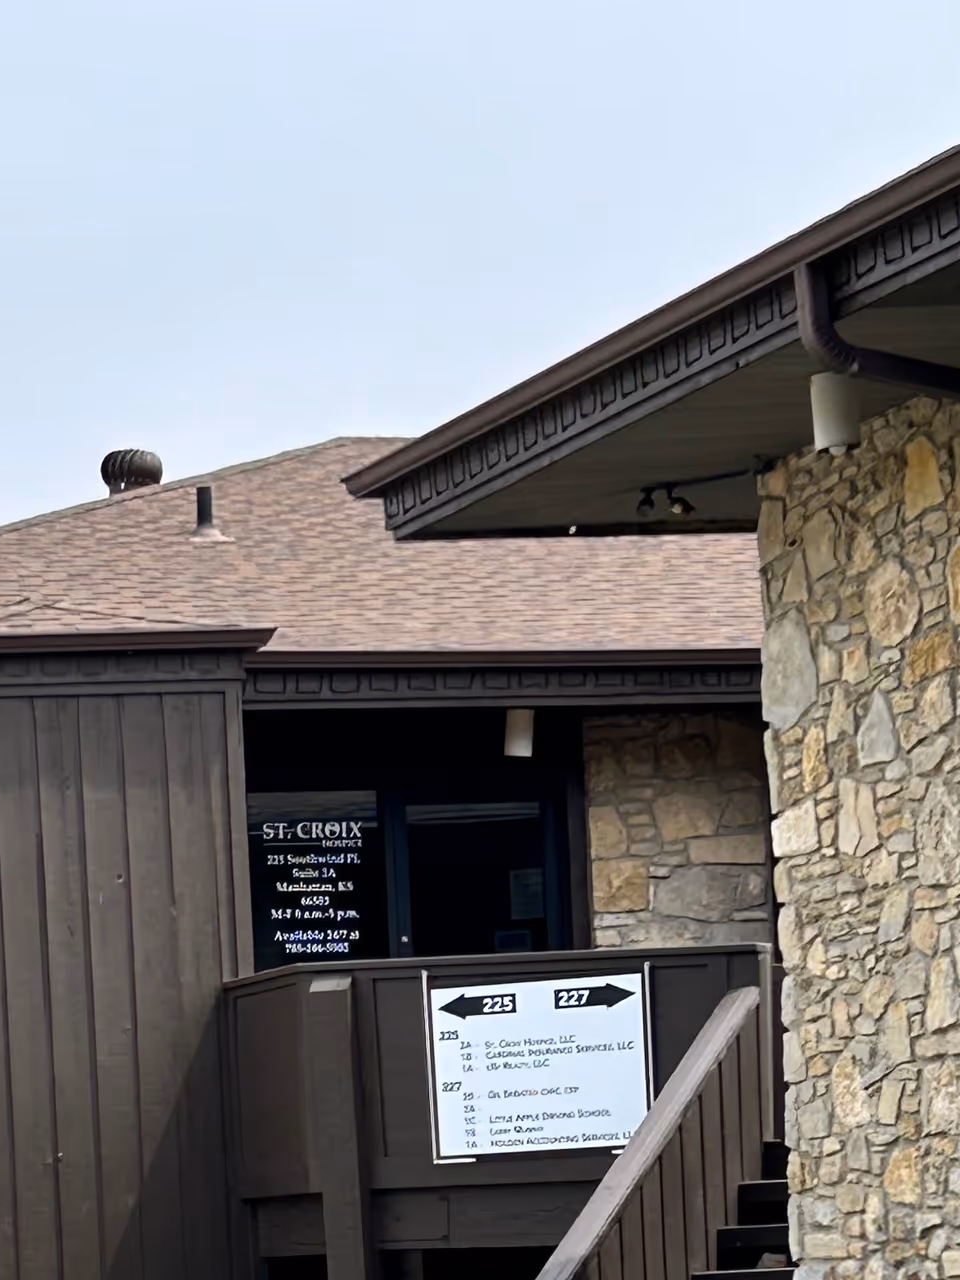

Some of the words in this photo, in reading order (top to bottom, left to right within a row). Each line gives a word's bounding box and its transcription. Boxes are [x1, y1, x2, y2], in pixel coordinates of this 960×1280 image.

[263, 823, 291, 839] ST.
[296, 821, 362, 838] CROIX
[482, 996, 514, 1013] 225
[557, 990, 590, 1006] 227
